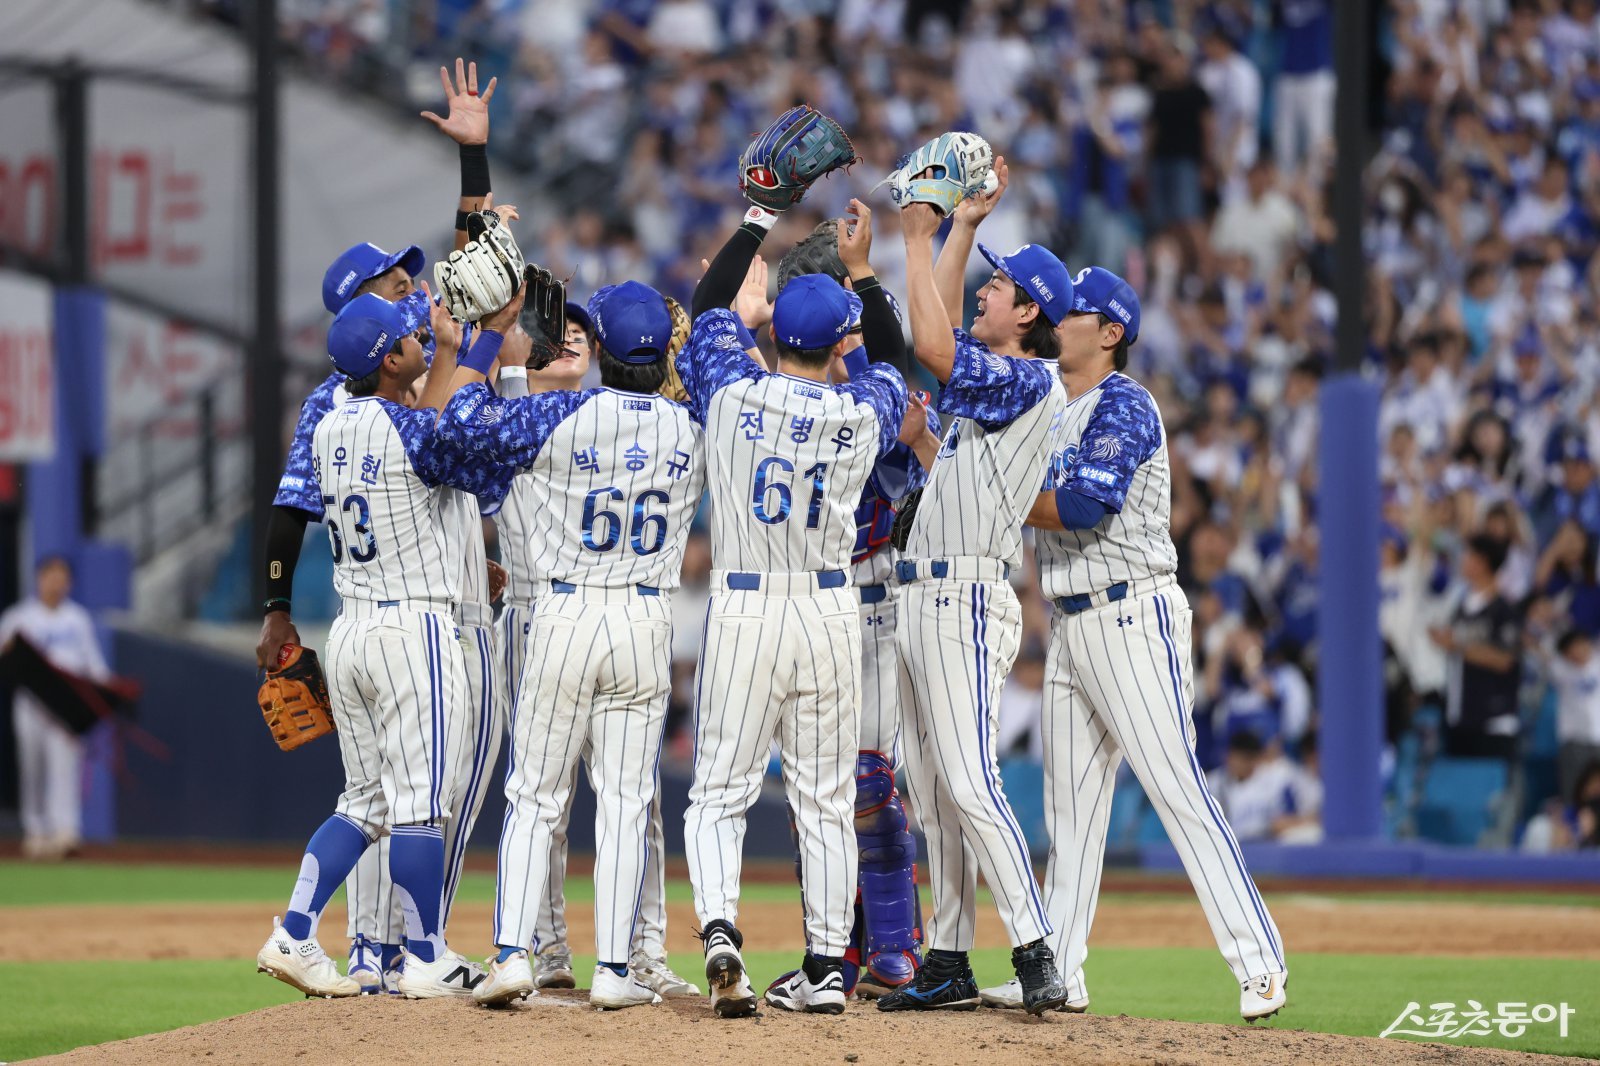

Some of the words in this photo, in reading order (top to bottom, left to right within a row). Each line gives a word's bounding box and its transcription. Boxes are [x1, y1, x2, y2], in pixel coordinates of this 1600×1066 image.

[1031, 275, 1055, 303] iM뱅크
[1108, 299, 1132, 323] iM뱅크
[367, 332, 388, 359] 대구대학교
[623, 400, 651, 411] 삼성카드
[794, 385, 823, 400] 삼성카드
[457, 393, 483, 421] 삼성생명
[740, 410, 854, 454] 전병우
[573, 442, 691, 480] 박송규
[1081, 466, 1116, 485] 삼성생명
[752, 456, 829, 530] 61
[323, 494, 378, 564] 53
[581, 486, 671, 556] 66
[270, 561, 282, 579] 0
